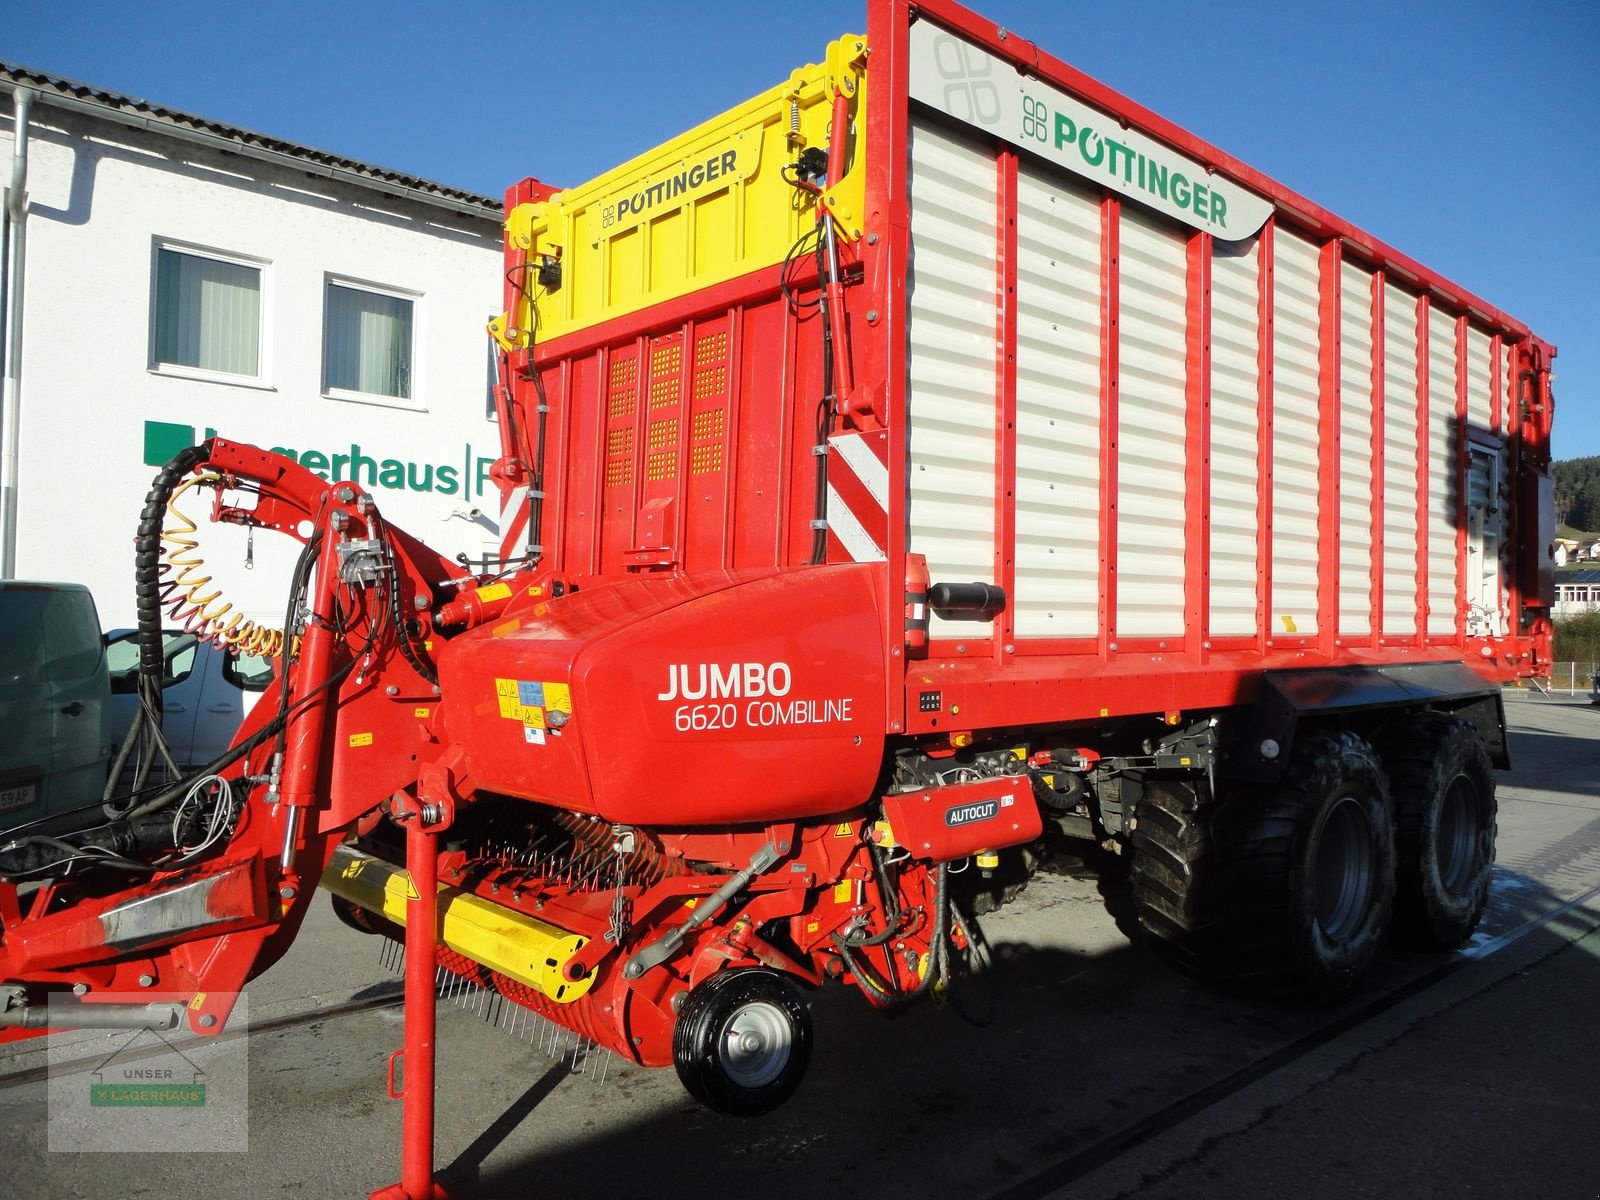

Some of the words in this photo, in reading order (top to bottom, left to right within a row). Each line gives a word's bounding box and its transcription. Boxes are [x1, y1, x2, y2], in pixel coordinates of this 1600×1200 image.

[617, 149, 737, 222] PÖTTINGER
[1054, 111, 1227, 229] PÖTTINGER
[205, 428, 459, 496] erhaus
[658, 661, 792, 701] JUMBO
[675, 703, 737, 732] 6620
[746, 698, 853, 727] COMBILINE
[950, 803, 994, 823] AUTOCUT
